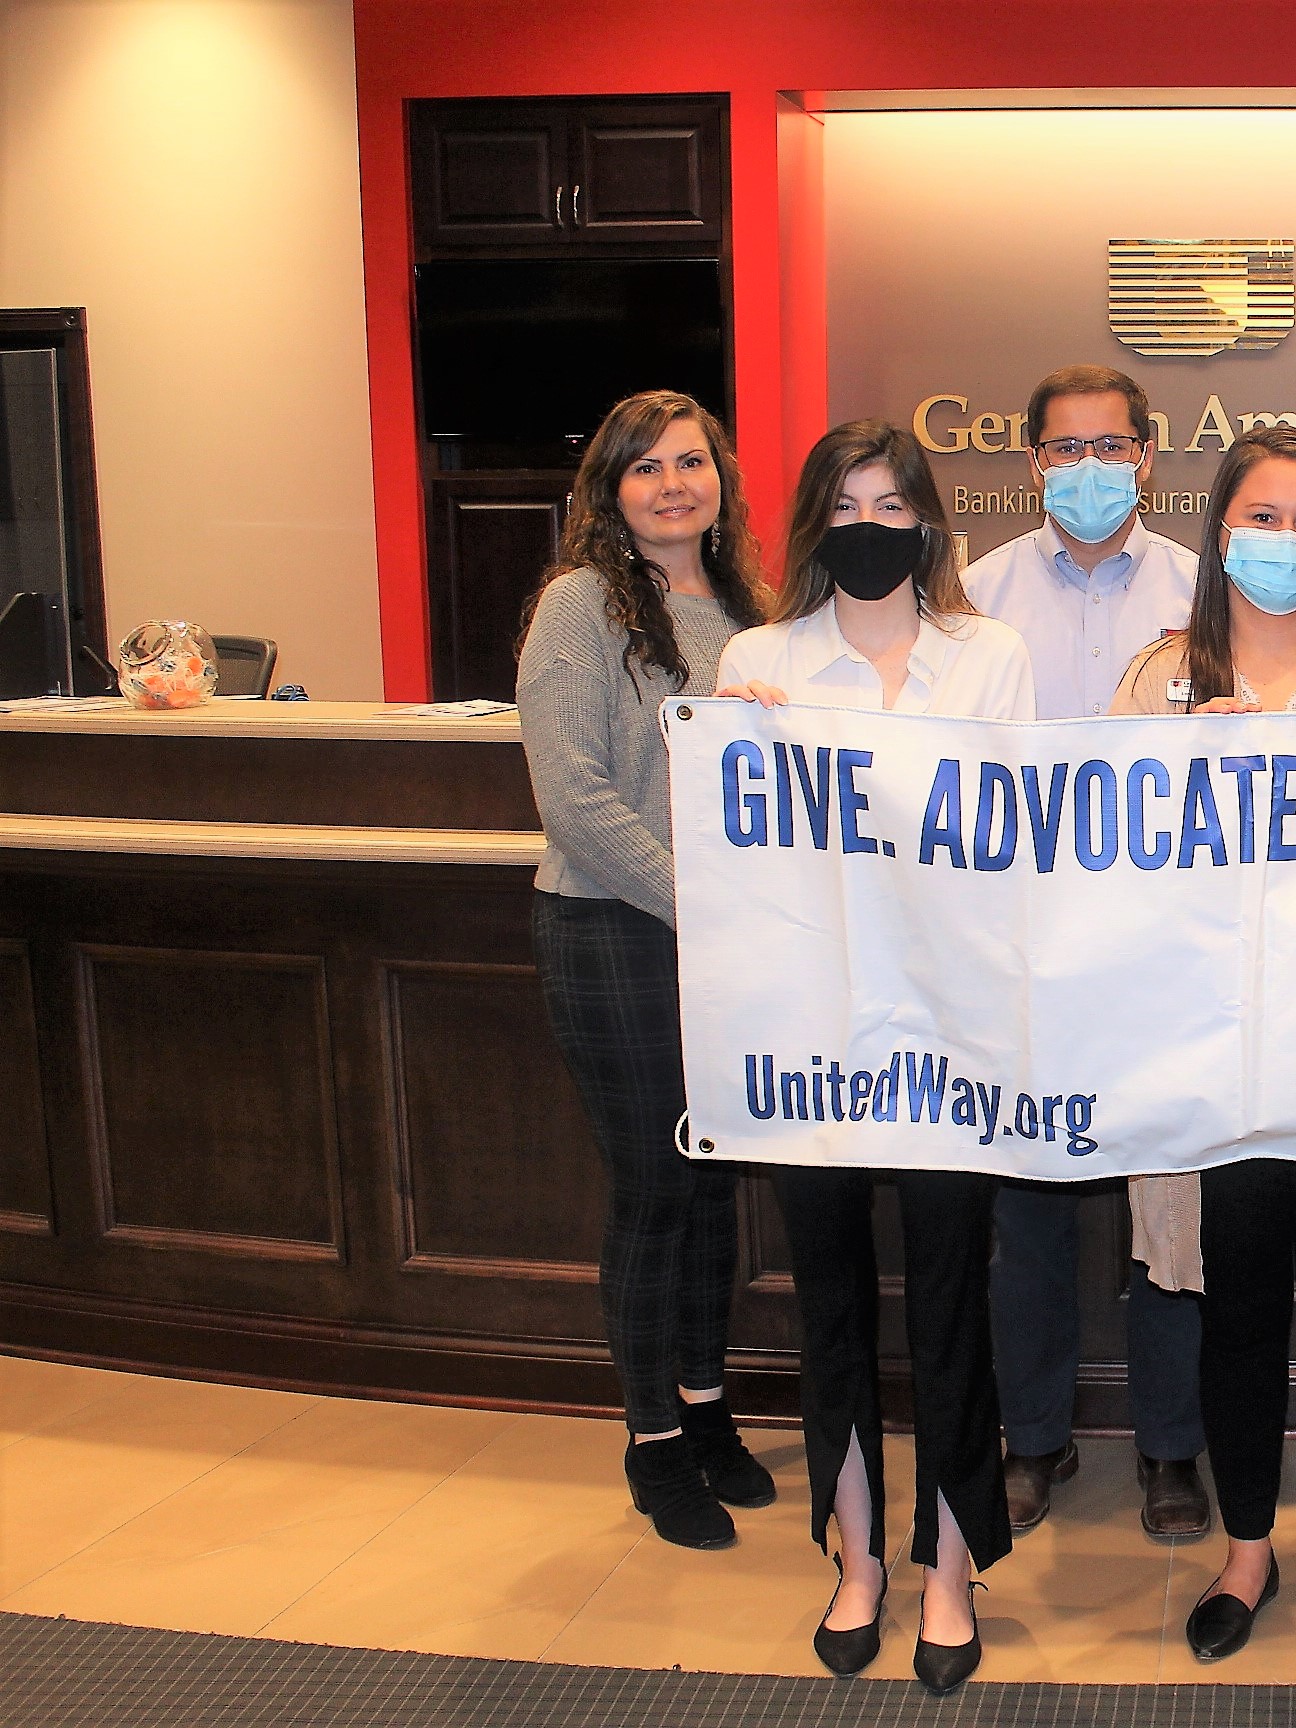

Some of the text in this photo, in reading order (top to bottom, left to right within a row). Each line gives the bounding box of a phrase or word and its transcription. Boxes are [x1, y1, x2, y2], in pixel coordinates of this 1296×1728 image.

[912, 394, 1175, 454] Gern
[954, 484, 1041, 514] Bankin
[721, 739, 897, 859] GIVE.
[744, 1051, 1099, 1157] UnitedWay.org
